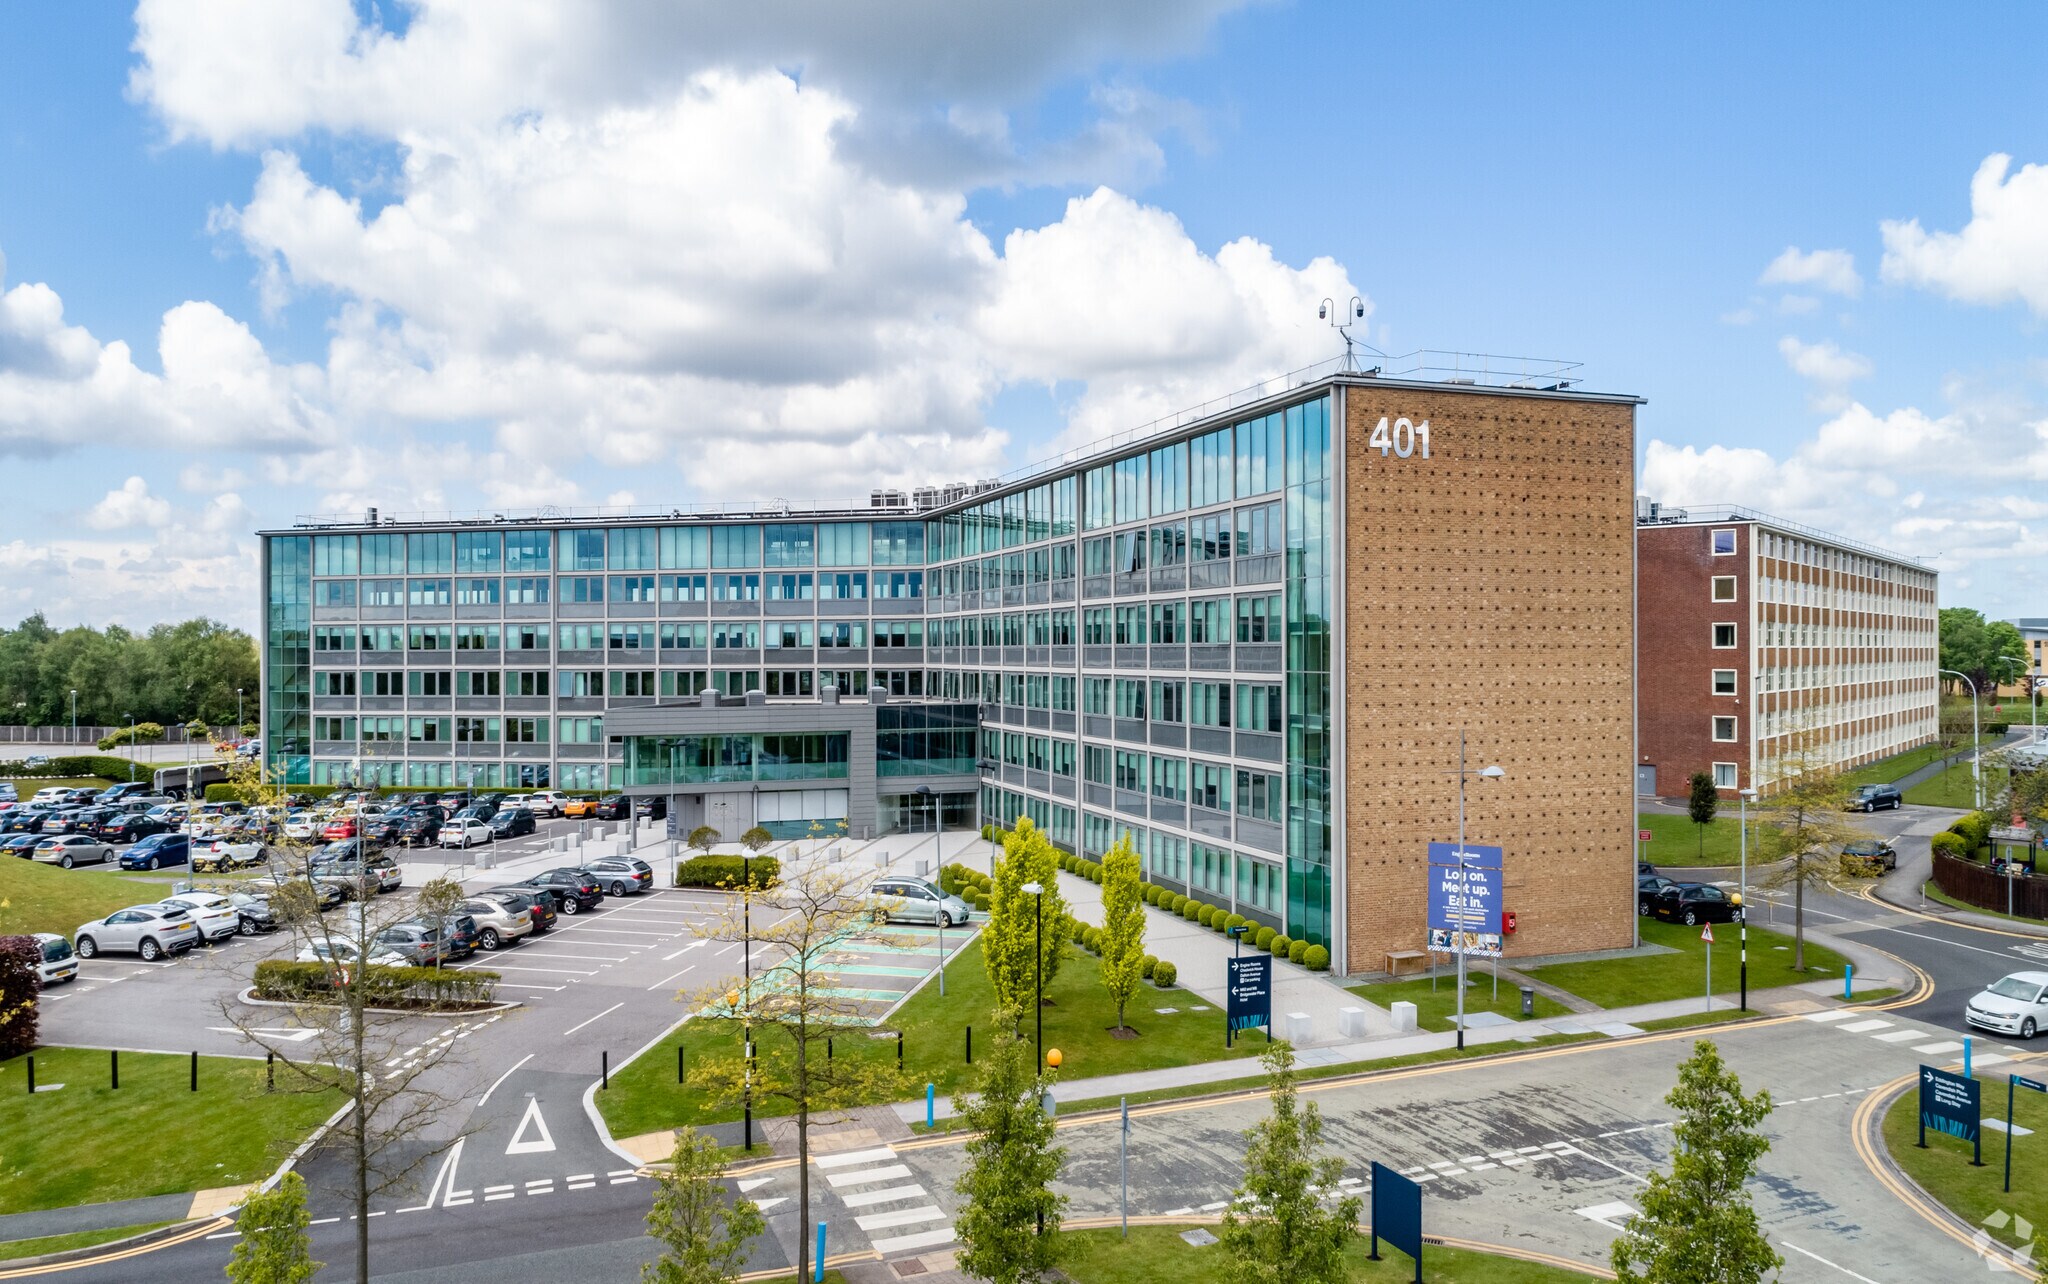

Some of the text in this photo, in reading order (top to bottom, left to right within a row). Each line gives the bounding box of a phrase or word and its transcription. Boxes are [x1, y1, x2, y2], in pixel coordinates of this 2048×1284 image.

[1369, 416, 1430, 459] 401
[1469, 872, 1487, 882] on.
[1472, 885, 1490, 897] up.
[1470, 896, 1483, 908] in.
